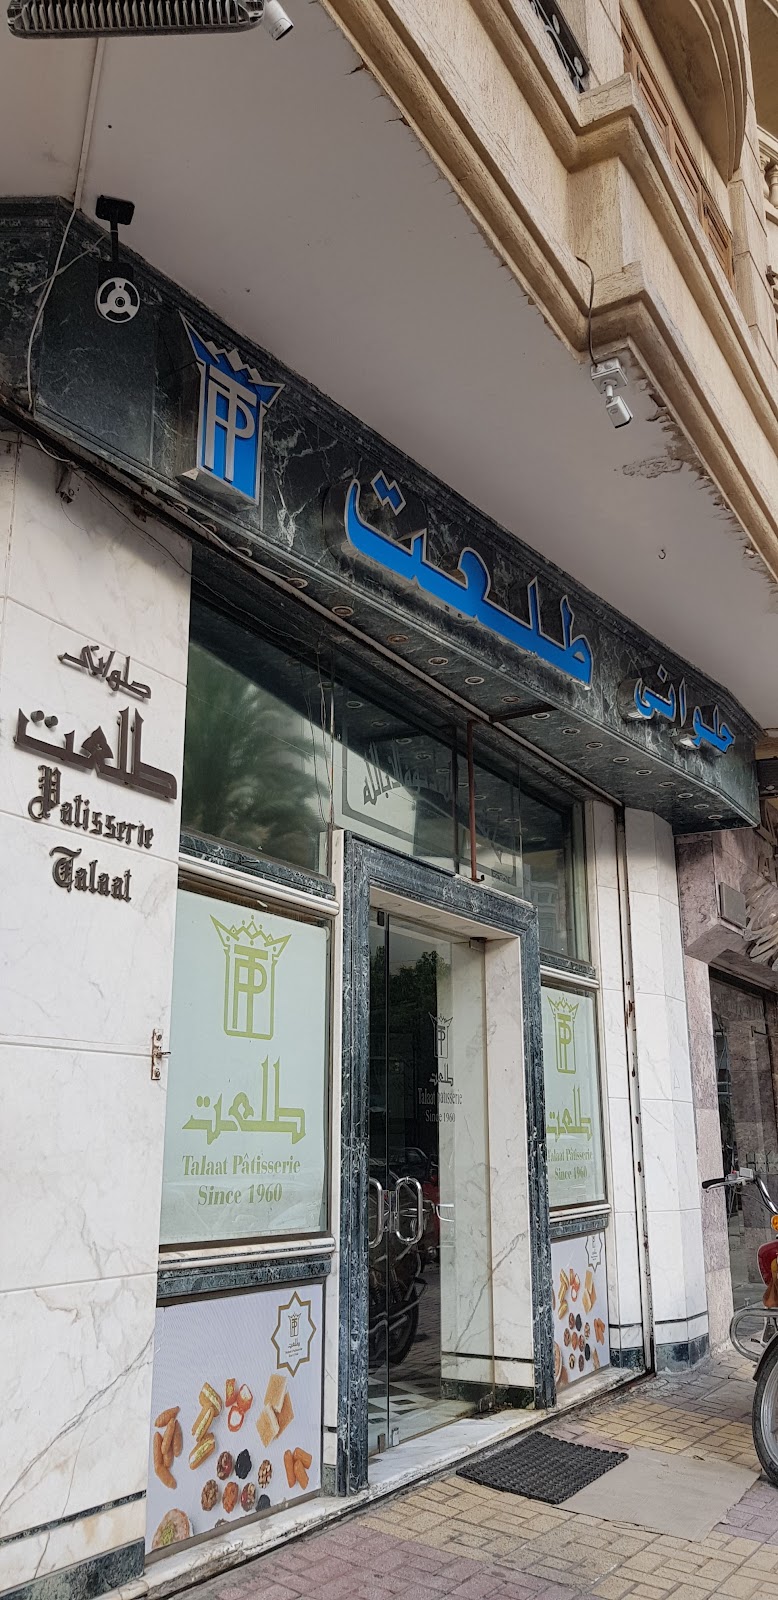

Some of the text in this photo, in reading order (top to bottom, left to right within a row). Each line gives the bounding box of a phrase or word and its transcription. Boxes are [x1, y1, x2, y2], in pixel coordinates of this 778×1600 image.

[344, 469, 594, 690] طلعت
[14, 706, 177, 800] طلعت
[28, 765, 154, 849] Patisserie
[49, 845, 132, 903] Talaat
[181, 1054, 307, 1145] طلعت
[417, 1087, 437, 1105] Talaat
[425, 1109, 456, 1123] Since 1960
[546, 1083, 593, 1142] طلعت
[182, 1152, 301, 1177] Talaat Pâtisserie
[554, 1165, 588, 1180] Since 1960
[198, 1182, 283, 1206] Since 1960
